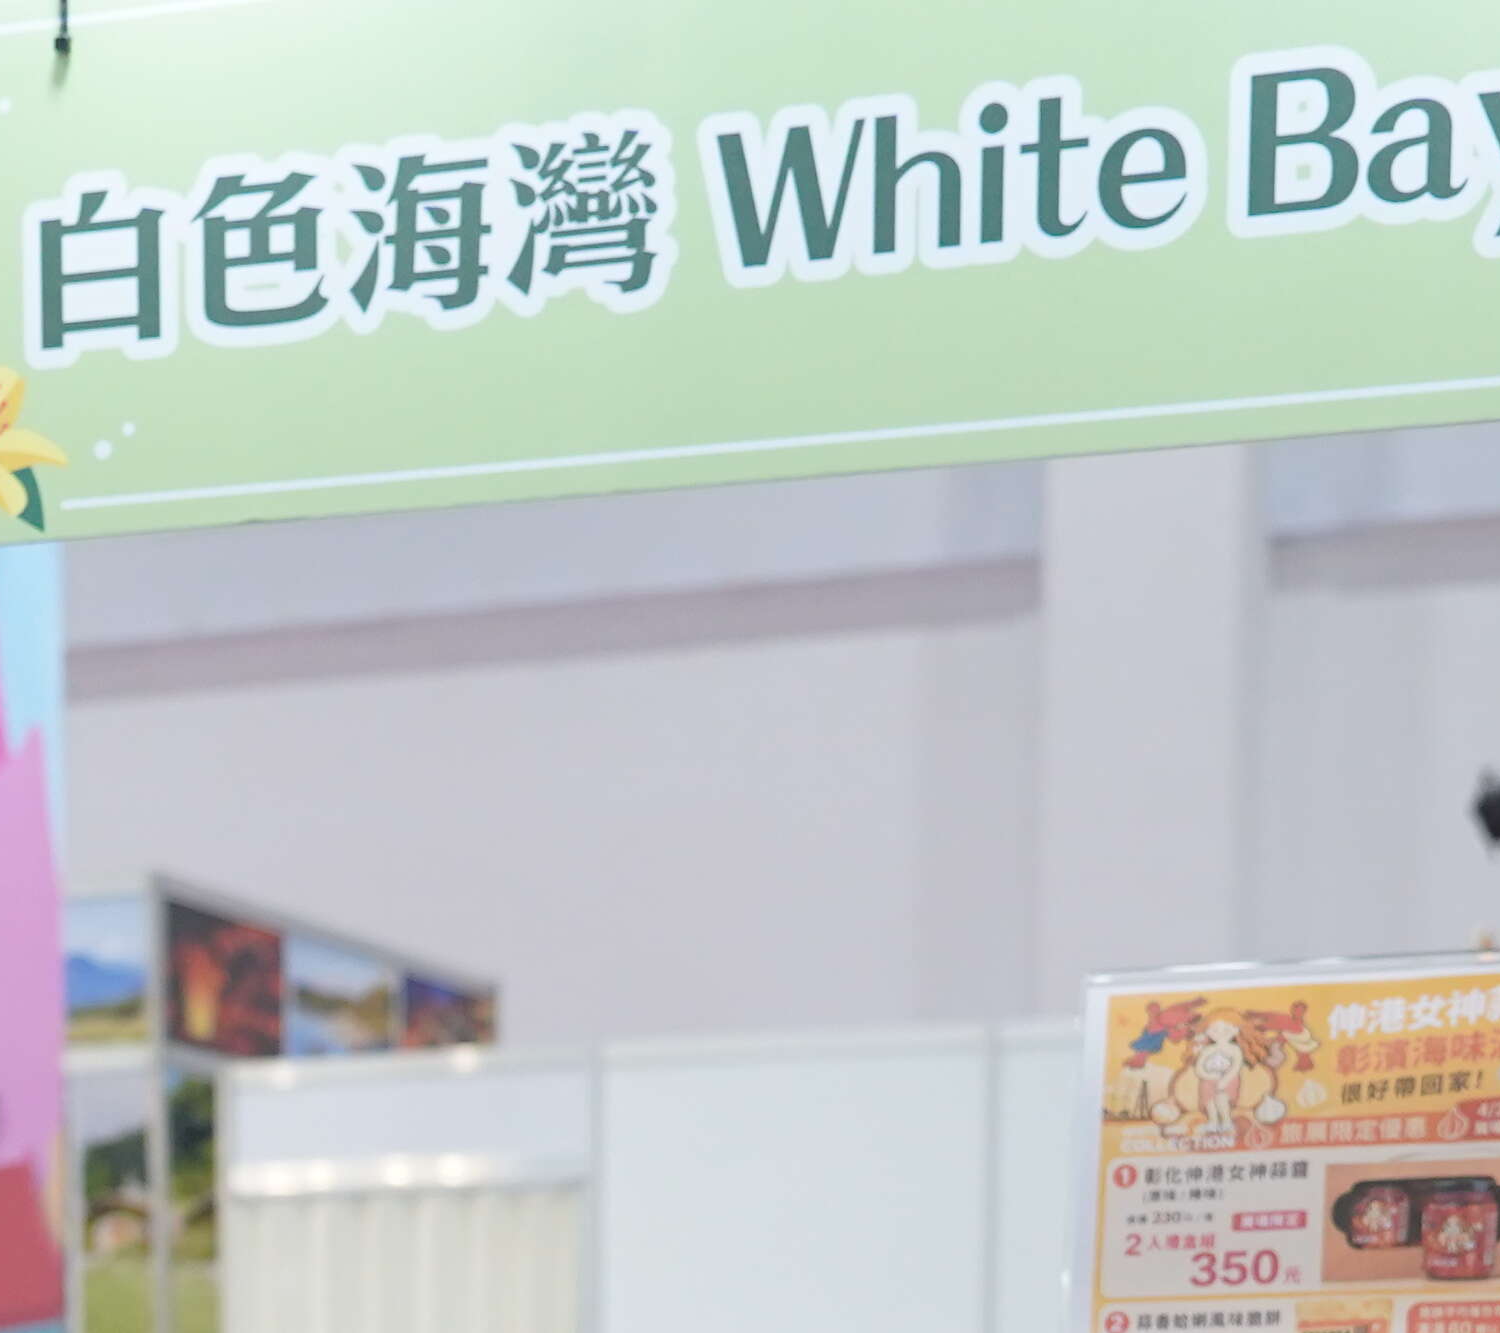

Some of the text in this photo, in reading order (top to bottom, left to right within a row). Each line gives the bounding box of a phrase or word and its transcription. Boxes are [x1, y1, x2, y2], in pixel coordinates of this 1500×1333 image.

[34, 128, 658, 352] 白色海灣
[719, 105, 1188, 272] White
[1190, 1249, 1280, 1287] 350
